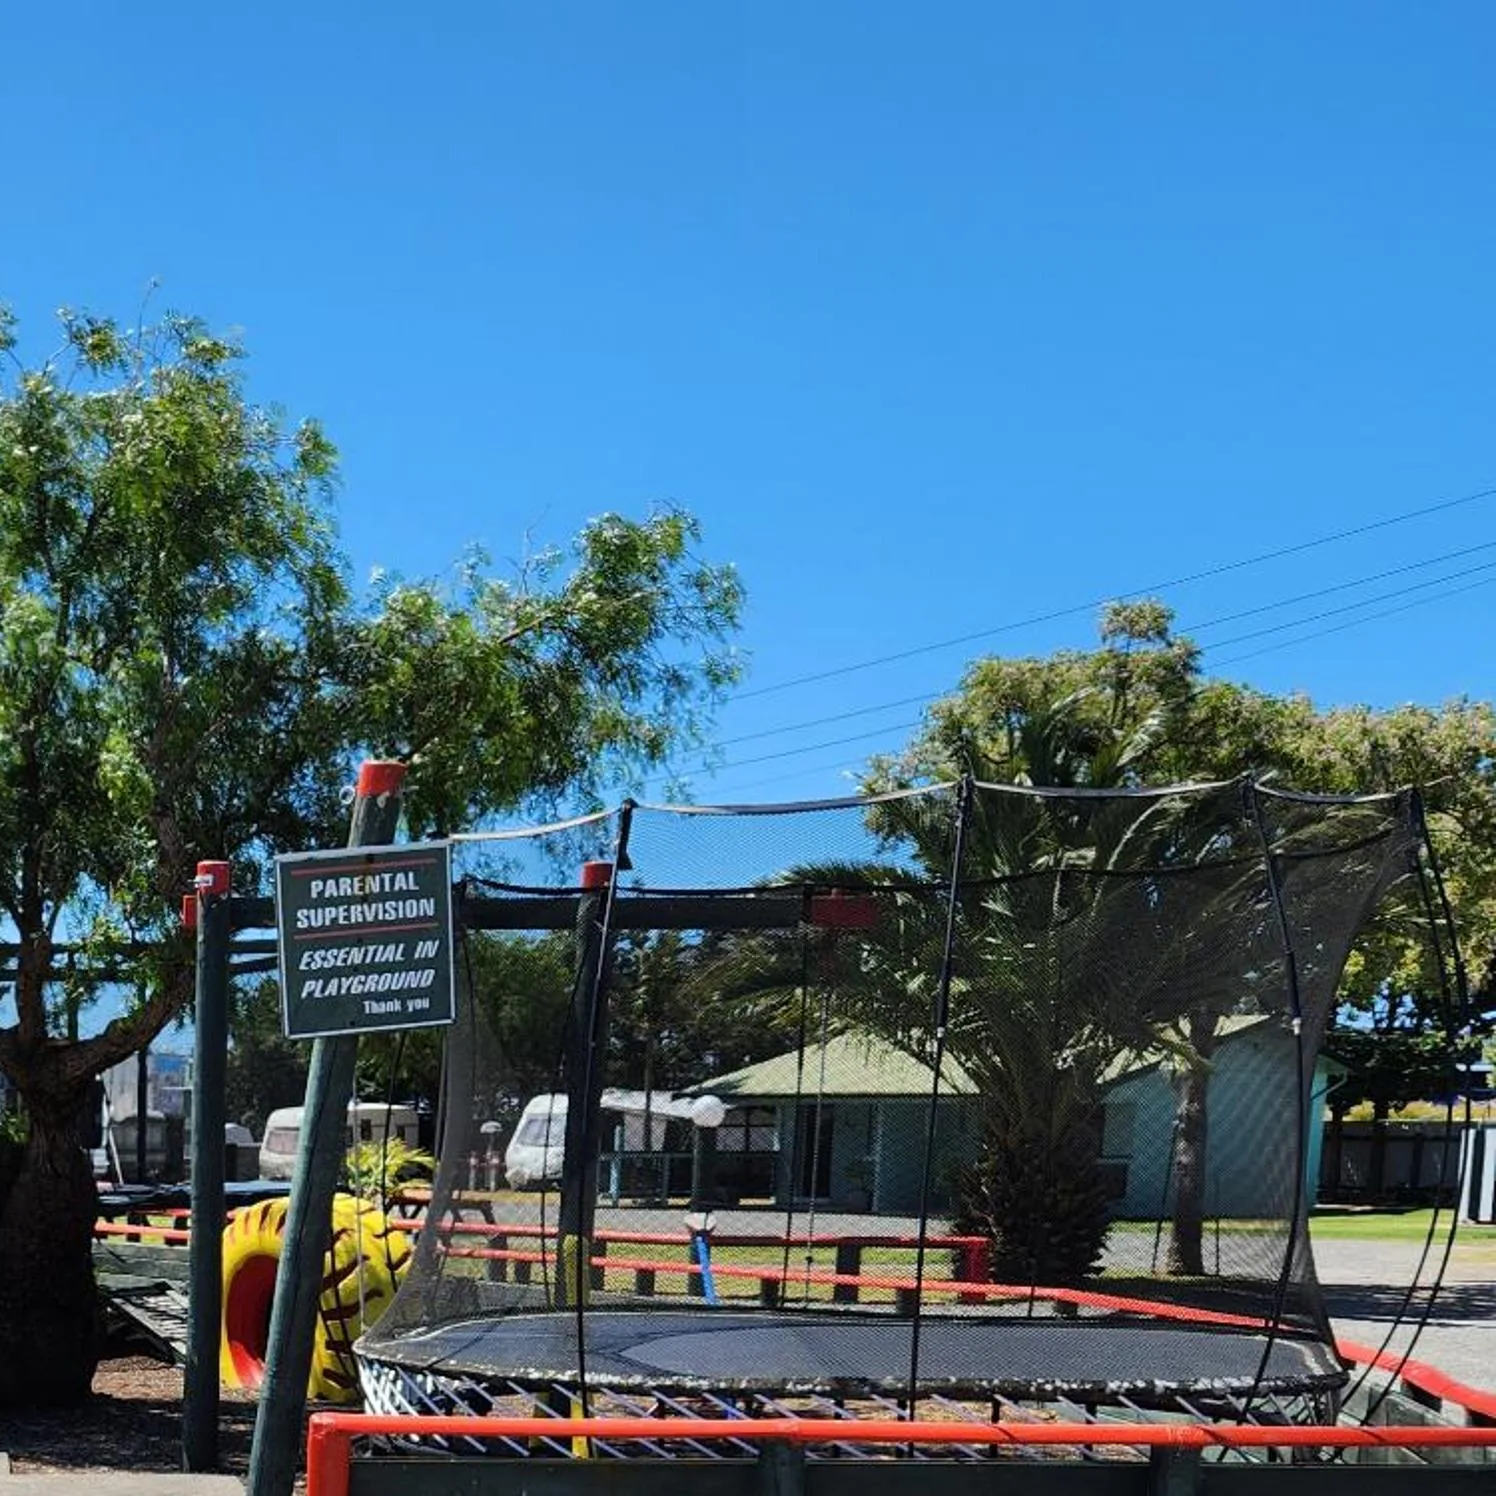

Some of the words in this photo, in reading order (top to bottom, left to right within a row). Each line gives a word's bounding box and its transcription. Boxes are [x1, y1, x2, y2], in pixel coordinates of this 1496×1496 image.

[310, 871, 419, 898] PARENTAL
[296, 898, 435, 929] SUPERVISION
[299, 943, 406, 970] ESSENTIAL
[414, 939, 440, 960] IN
[301, 969, 436, 998] PLAYGROUND
[363, 999, 402, 1014] Thank
[407, 998, 430, 1012] you
